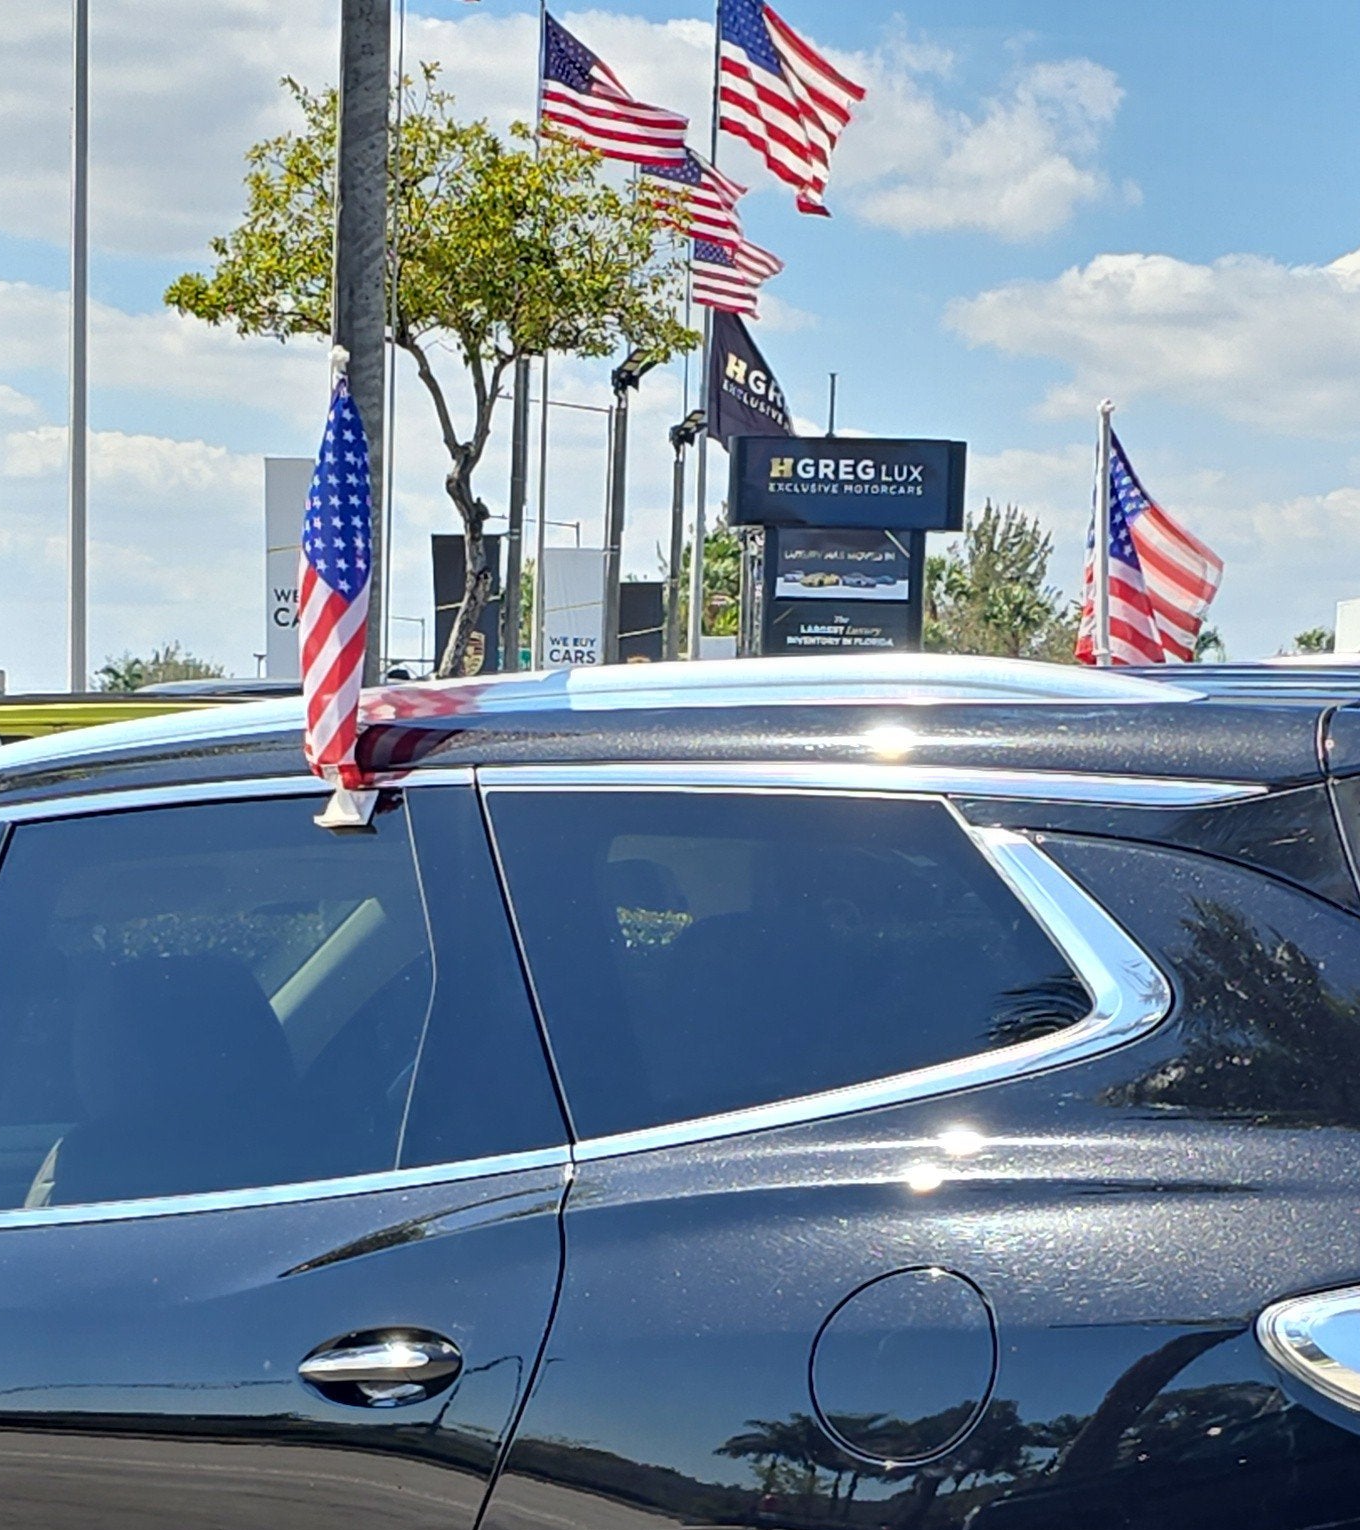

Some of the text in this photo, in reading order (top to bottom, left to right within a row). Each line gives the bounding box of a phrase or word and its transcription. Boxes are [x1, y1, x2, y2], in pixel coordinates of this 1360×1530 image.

[725, 352, 787, 409] HGR
[881, 465, 925, 482] LUX
[768, 483, 924, 496] EXCLUSIVE MOTORCARS
[549, 636, 570, 648] WE
[549, 649, 597, 665] CARS
